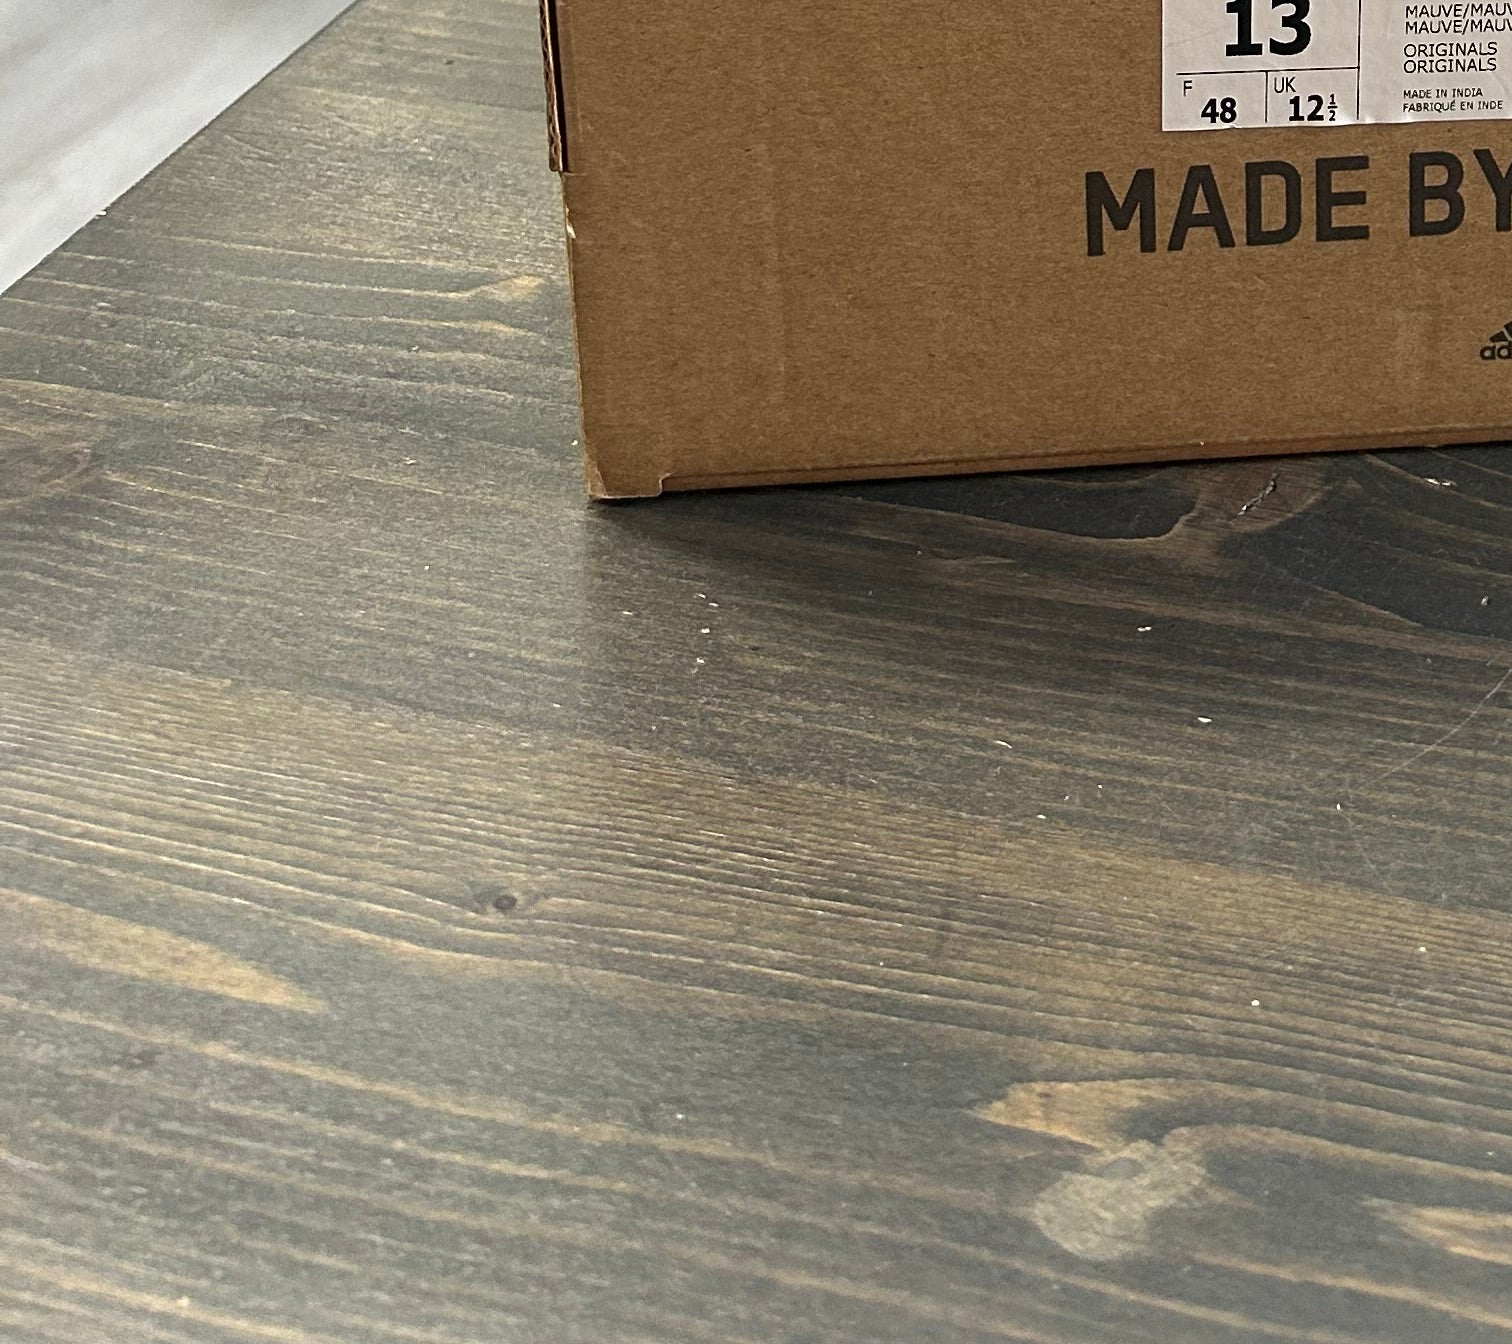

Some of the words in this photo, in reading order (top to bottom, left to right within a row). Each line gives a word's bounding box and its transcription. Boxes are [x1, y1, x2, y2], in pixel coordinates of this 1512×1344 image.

[1403, 41, 1498, 58] ORIGINALS
[1403, 58, 1497, 74] ORIGINALS
[1182, 80, 1193, 97] F
[1273, 76, 1297, 94] UK
[1403, 89, 1432, 98] MADE
[1436, 89, 1448, 98] IN
[1452, 87, 1483, 98] INDIA
[1200, 97, 1237, 124] 48
[1403, 99, 1456, 113] FABRIQUÉ
[1460, 102, 1474, 111] EN
[1477, 100, 1503, 111] INDE
[1085, 155, 1370, 256] MADE
